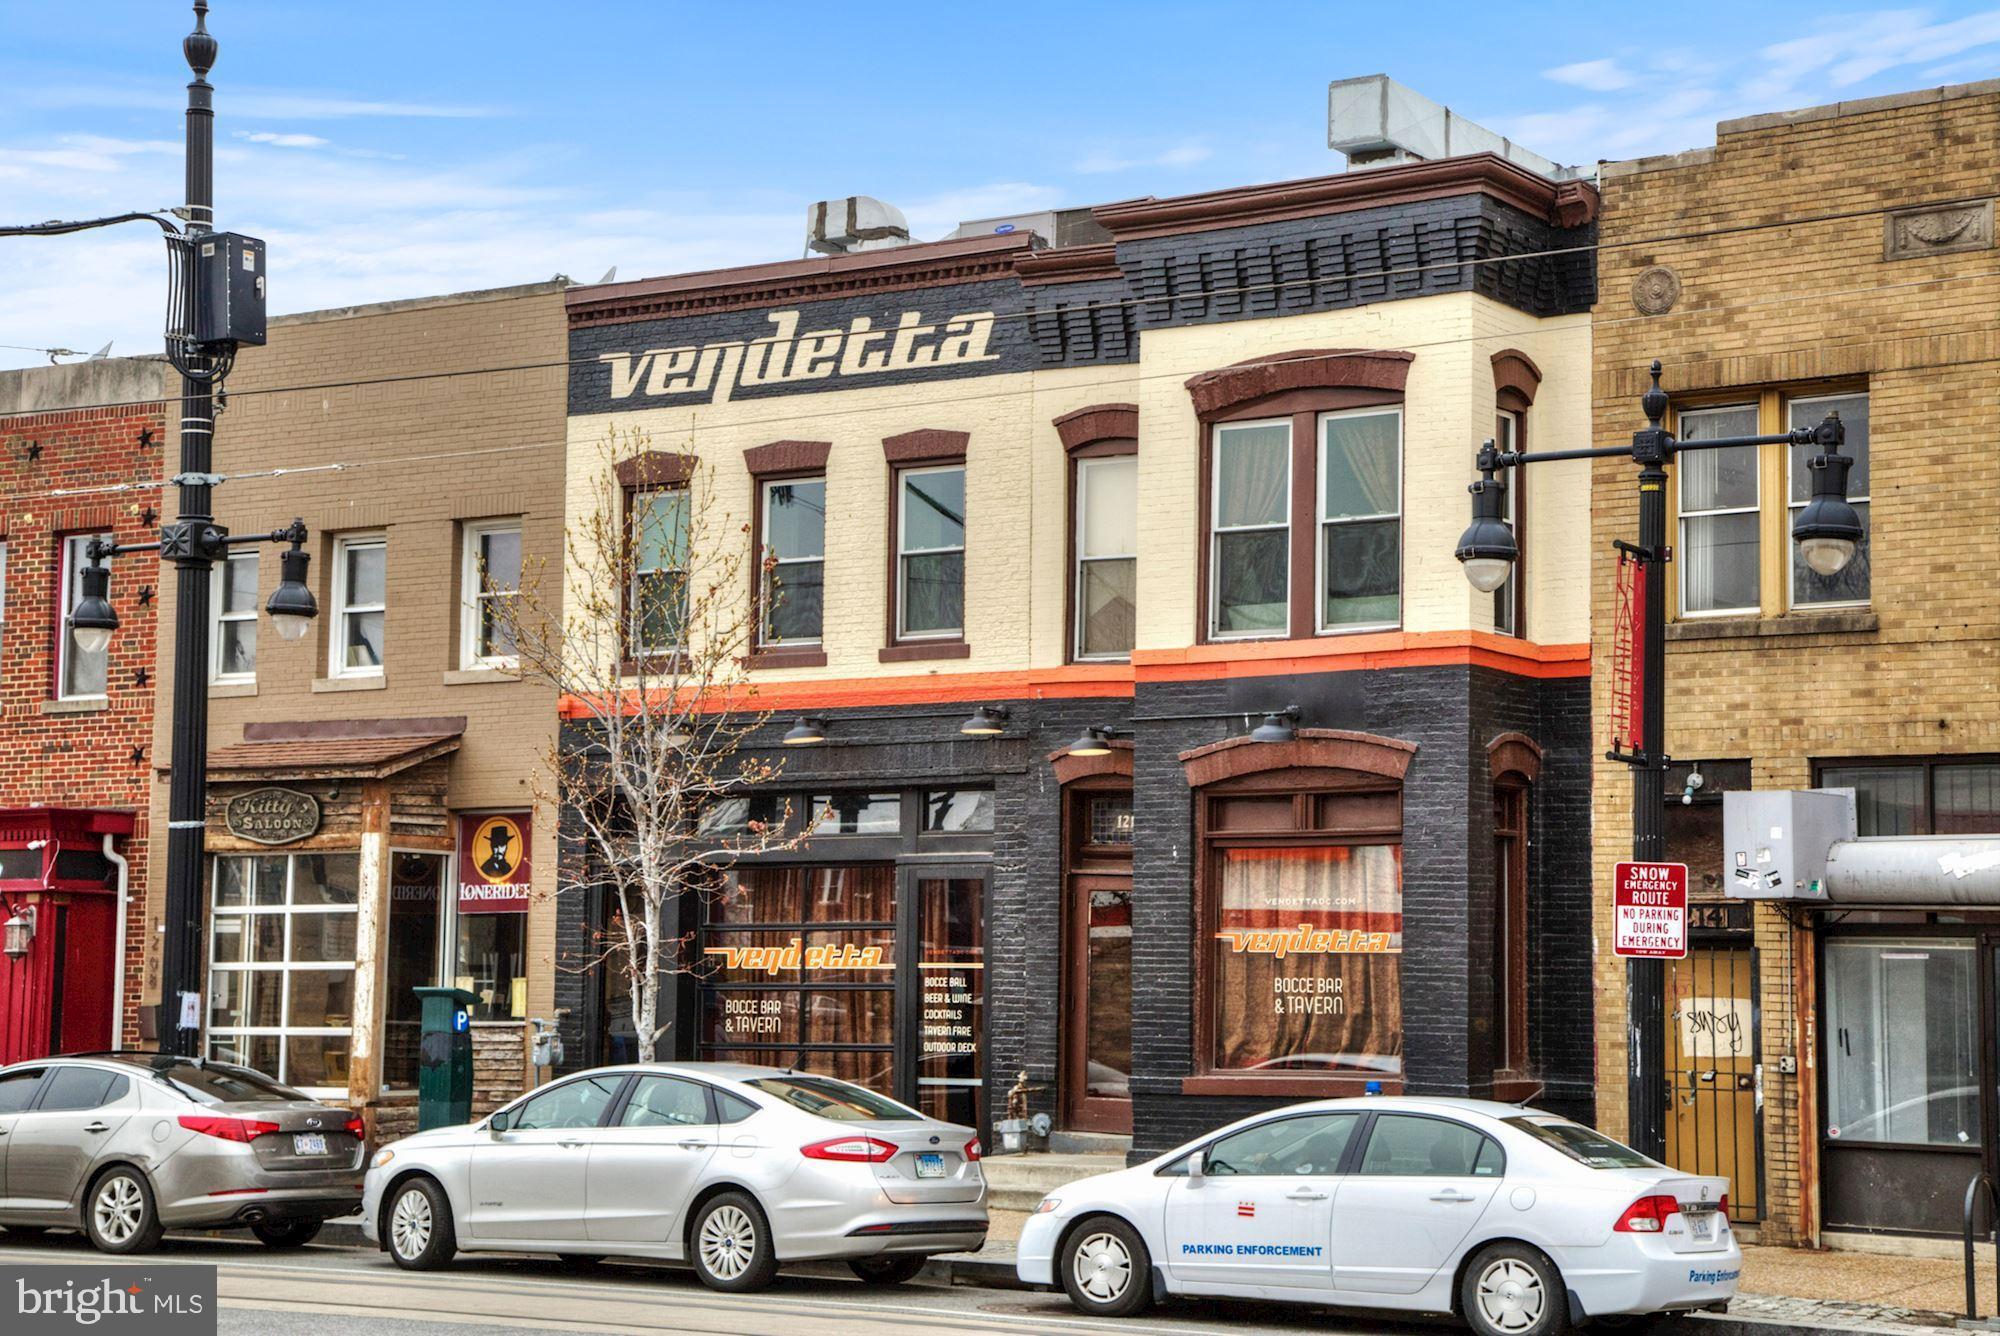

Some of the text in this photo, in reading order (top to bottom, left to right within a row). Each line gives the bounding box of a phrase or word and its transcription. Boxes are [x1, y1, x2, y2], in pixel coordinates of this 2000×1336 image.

[599, 311, 1000, 405] vendetta
[237, 796, 308, 818] Kitty's
[243, 817, 302, 830] SALOON
[1630, 867, 1670, 880] SNOW
[1624, 880, 1678, 890] EMERGENCY
[1265, 898, 1356, 906] VENDETTADC.COM
[1632, 891, 1670, 905] ROUTE
[1623, 908, 1679, 921] NO PARKING
[1633, 922, 1669, 934] DURING
[1215, 924, 1402, 959] vendetta
[1622, 935, 1680, 948] EMERGENCY
[704, 938, 896, 976] vendetta
[924, 977, 967, 988] BOCCE BALL
[1274, 977, 1343, 994] BOCCE BAR
[924, 993, 972, 1004] BEER & WINE
[725, 1000, 781, 1015] BOCCE BAR
[1274, 996, 1343, 1015] & TAVERN
[457, 1010, 467, 1030] P
[924, 1009, 962, 1020] COCKTAILS
[725, 1017, 781, 1033] & TAVERN
[924, 1026, 972, 1037] TAVERN FARE
[923, 1042, 977, 1053] OUTDOOR DECK
[1183, 1244, 1323, 1257] PARKING ENFORCEMENT
[1688, 1269, 1716, 1285] Parking
